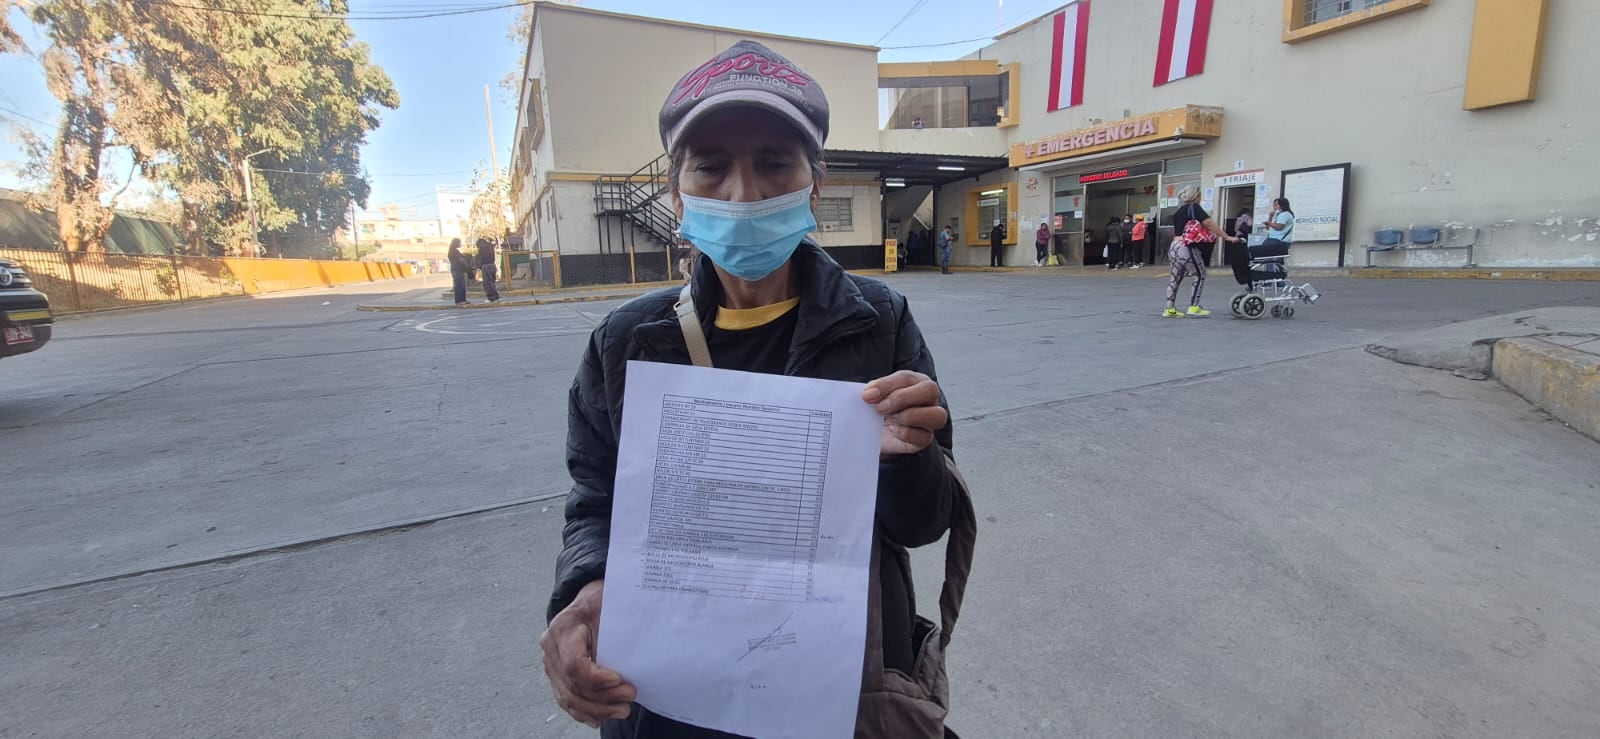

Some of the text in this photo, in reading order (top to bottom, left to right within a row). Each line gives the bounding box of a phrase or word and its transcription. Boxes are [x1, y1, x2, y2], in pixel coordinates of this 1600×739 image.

[673, 53, 811, 106] Sports
[729, 74, 788, 89] FUNCTION
[1037, 117, 1158, 157] EMERGENCIA
[1228, 173, 1257, 183] TRIAJE
[1319, 215, 1338, 224] SOCIAL
